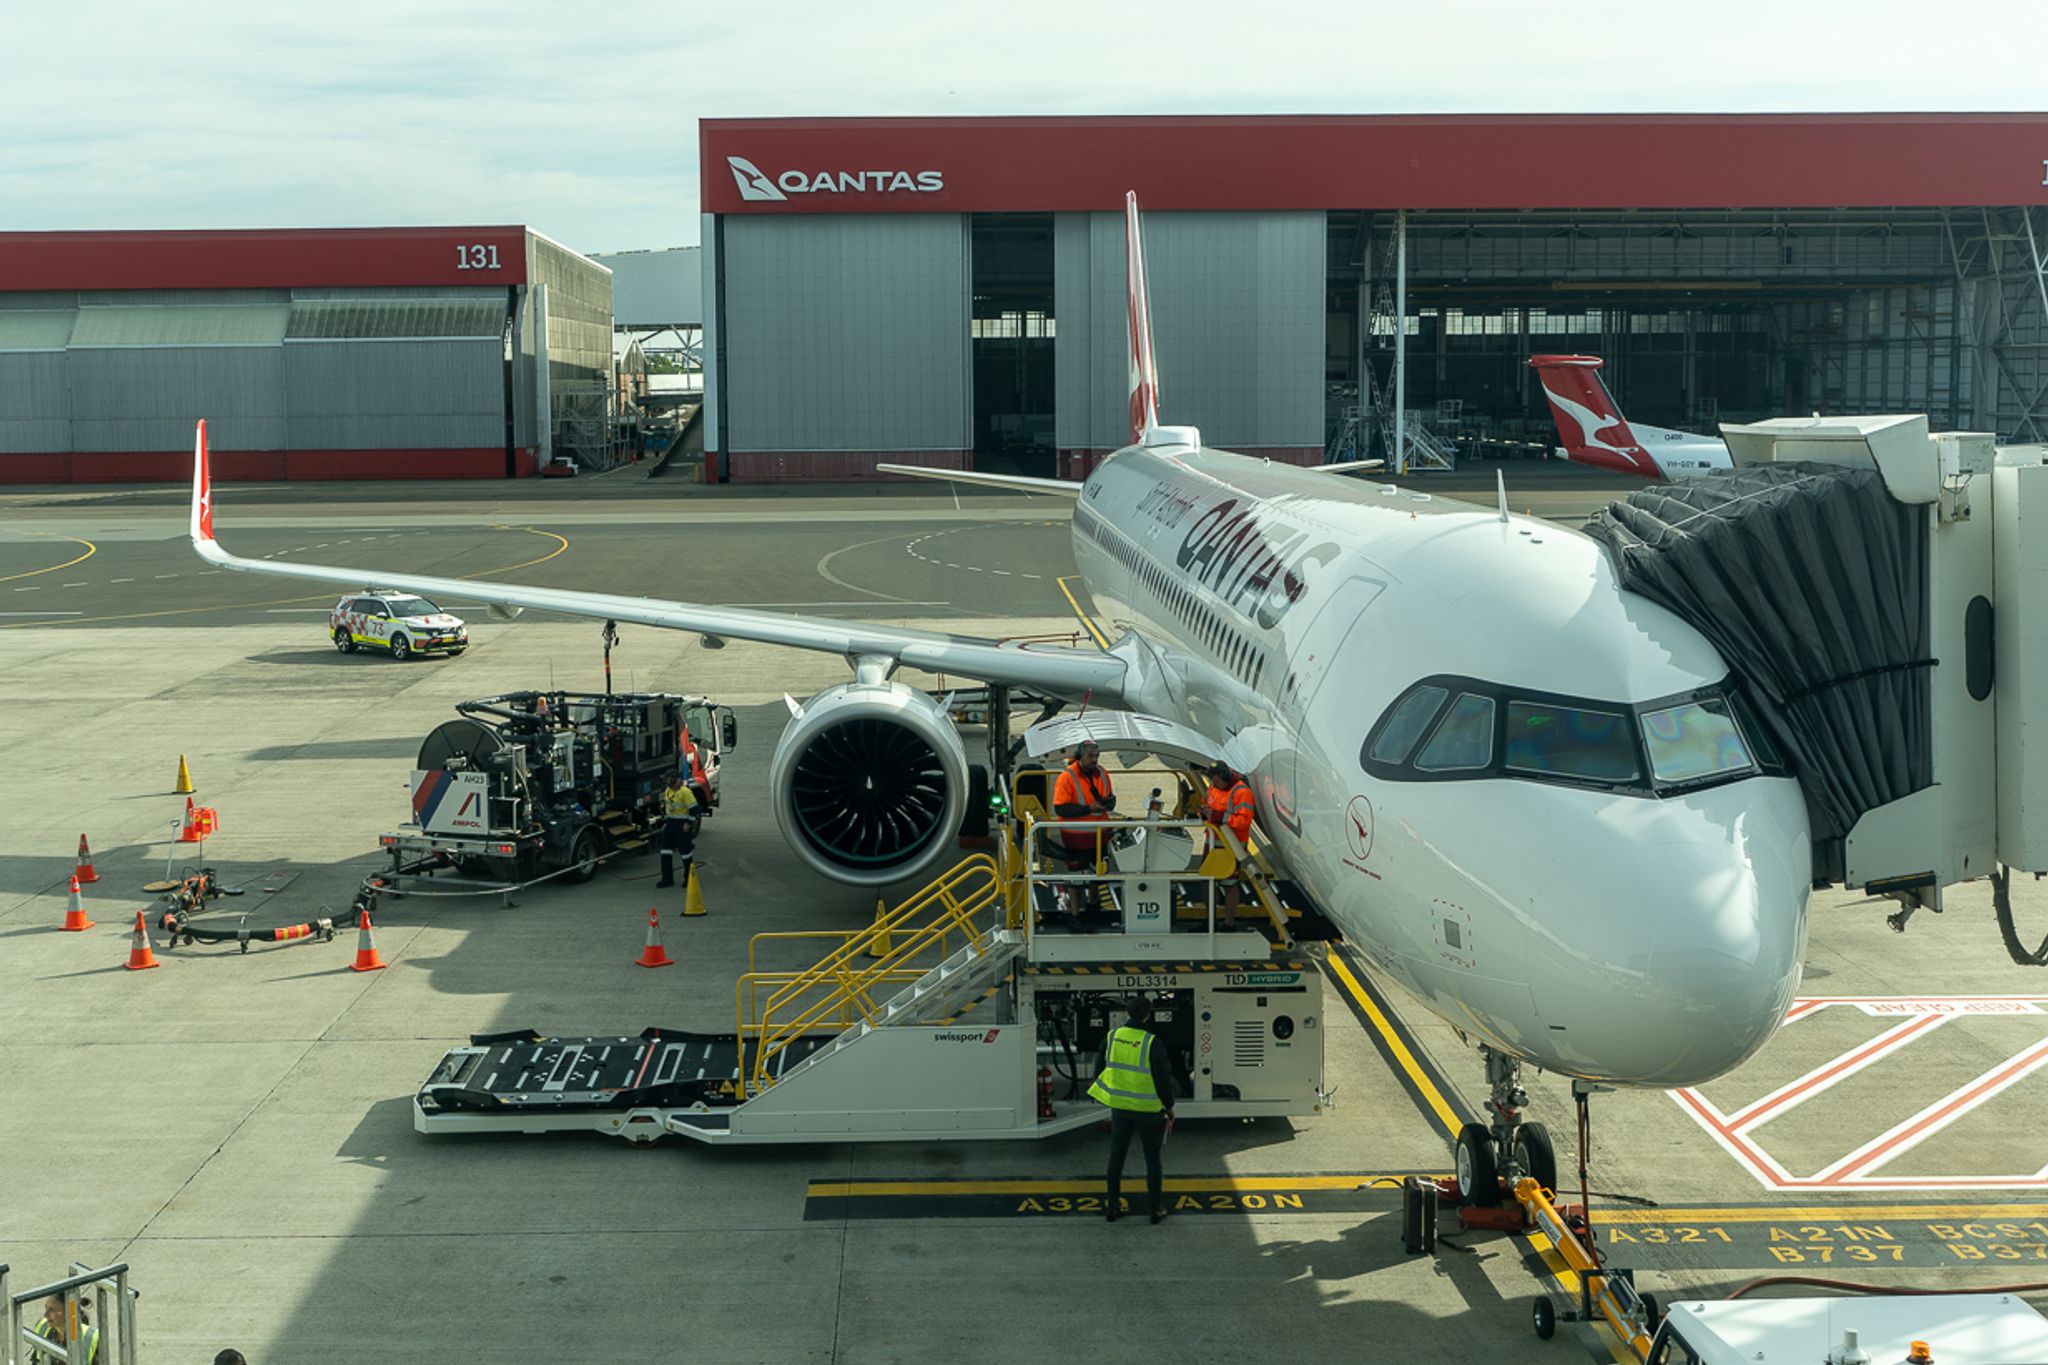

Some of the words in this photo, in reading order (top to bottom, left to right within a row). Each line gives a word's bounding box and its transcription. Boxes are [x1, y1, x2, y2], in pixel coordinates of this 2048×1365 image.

[778, 170, 944, 192] QANTAS
[457, 244, 501, 269] 131
[1664, 433, 1684, 441] Q400
[1177, 499, 1342, 630] QANTAS
[373, 621, 385, 636] 73
[464, 775, 485, 783] AH23
[452, 820, 481, 828] AMPOL
[1137, 902, 1160, 914] TLD
[1117, 976, 1177, 987] LDL3314
[1224, 974, 1247, 985] TLD
[1252, 975, 1292, 983] HYBRID
[934, 1031, 983, 1043] swissport
[1174, 1194, 1305, 1210] A20N
[1609, 1227, 1733, 1244] A321
[1768, 1225, 1895, 1242] A21N
[1768, 1245, 1905, 1263] B737
